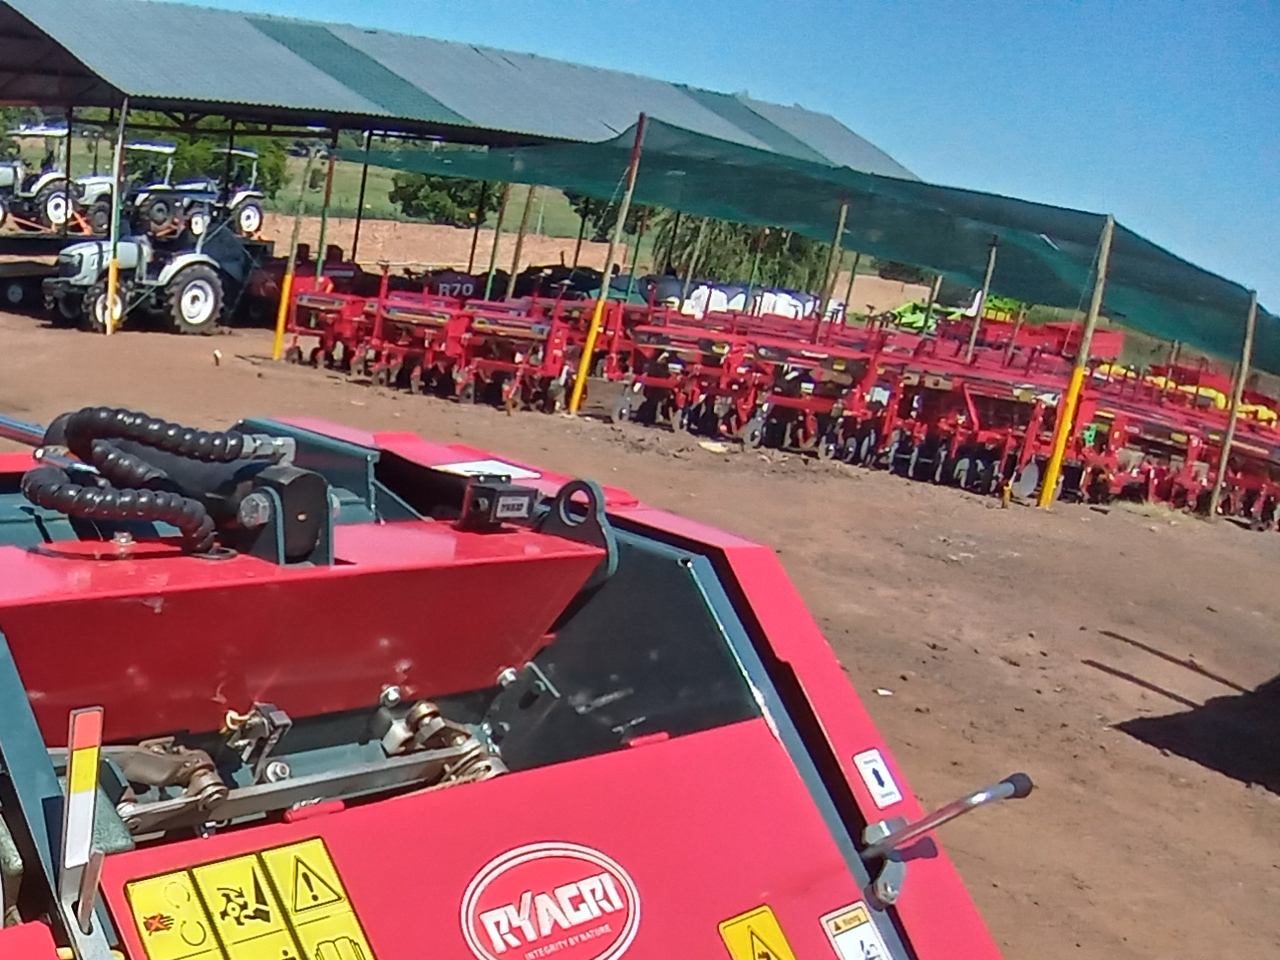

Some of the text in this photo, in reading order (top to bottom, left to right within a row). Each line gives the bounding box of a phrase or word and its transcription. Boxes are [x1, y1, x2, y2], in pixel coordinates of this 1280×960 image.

[439, 283, 474, 297] R70
[479, 872, 624, 954] RYAGRI
[524, 923, 612, 960] INTEGRITY BY NATURE
